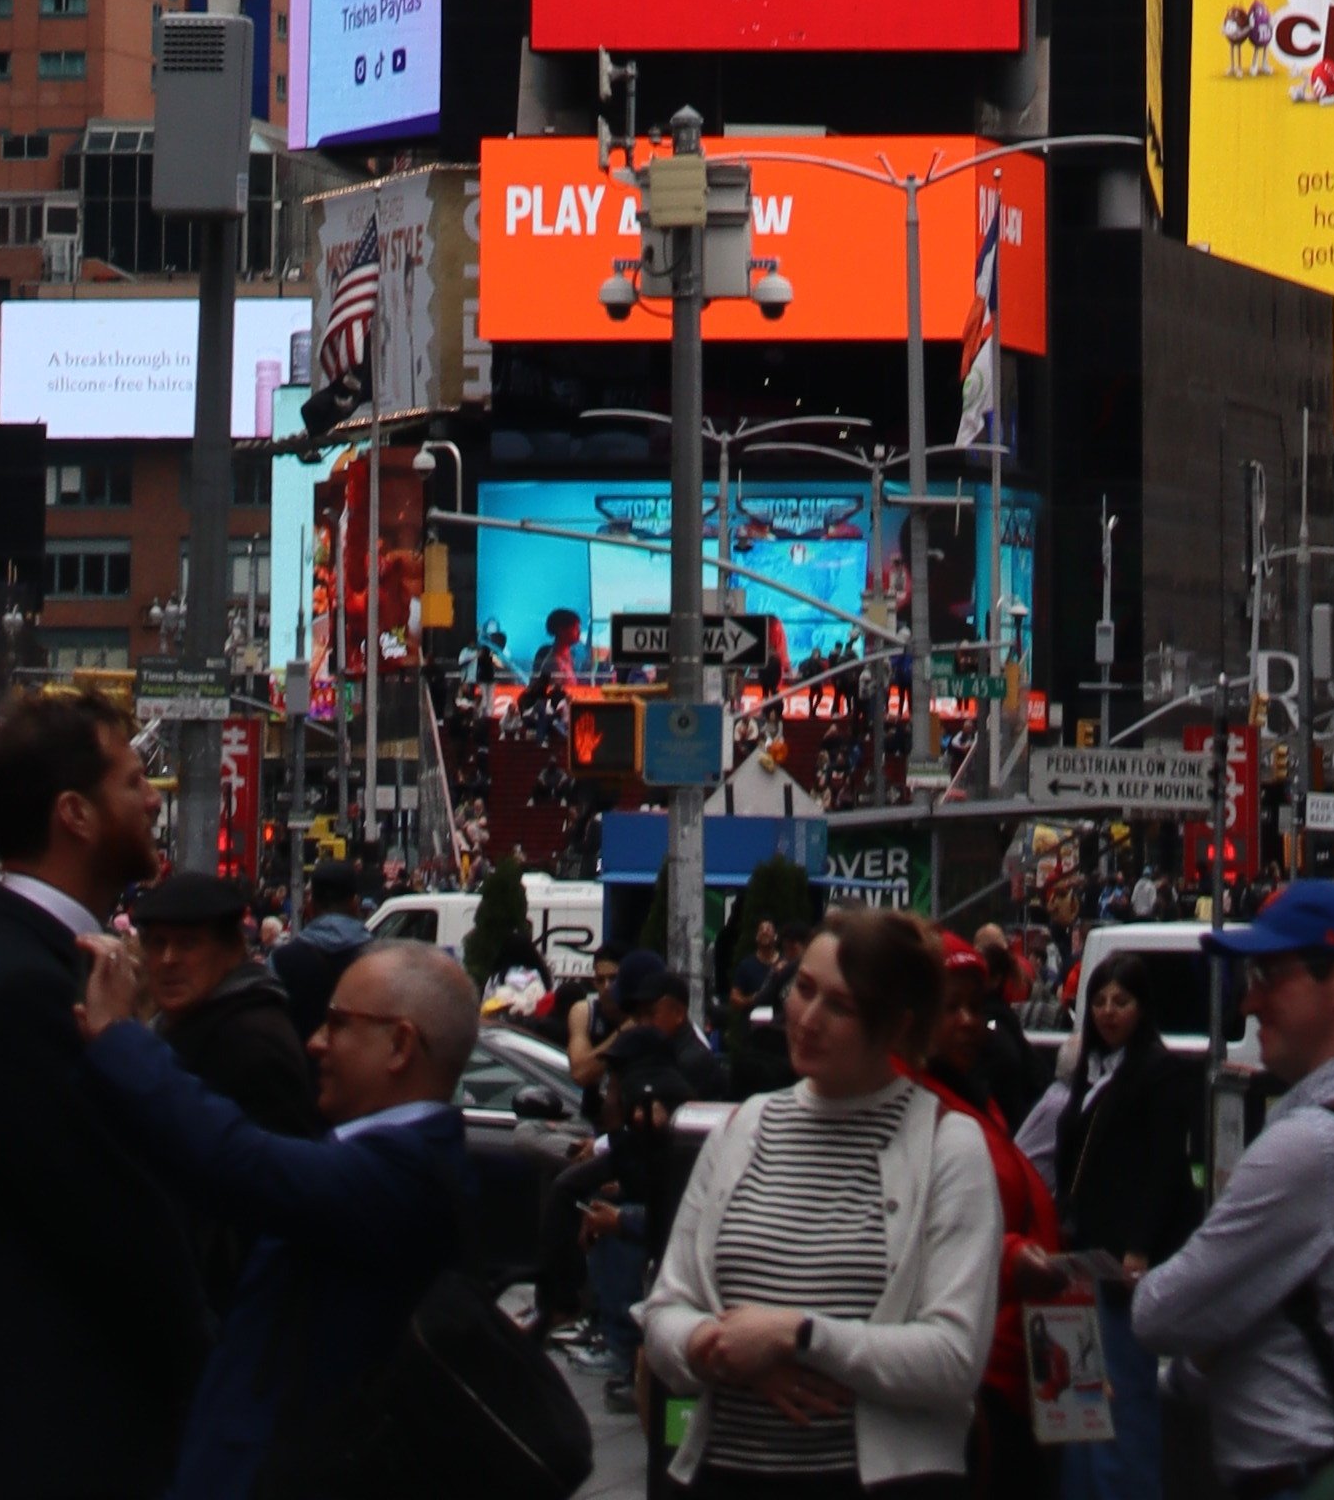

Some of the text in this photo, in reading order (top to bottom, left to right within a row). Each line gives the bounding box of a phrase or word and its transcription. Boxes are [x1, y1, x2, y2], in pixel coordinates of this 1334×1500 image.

[341, 3, 377, 35] Trisha
[1297, 171, 1334, 196] got
[505, 185, 605, 236] PLAY
[48, 351, 191, 371] A breakthrough in
[47, 376, 143, 393] silicone-free
[634, 629, 670, 648] ON
[142, 670, 215, 684] Times Square
[950, 681, 967, 695] W
[971, 680, 990, 695] 45
[1047, 757, 1204, 775] PEDESTRIAN FLOW ZONE
[1117, 783, 1204, 799] KEEP MOVING
